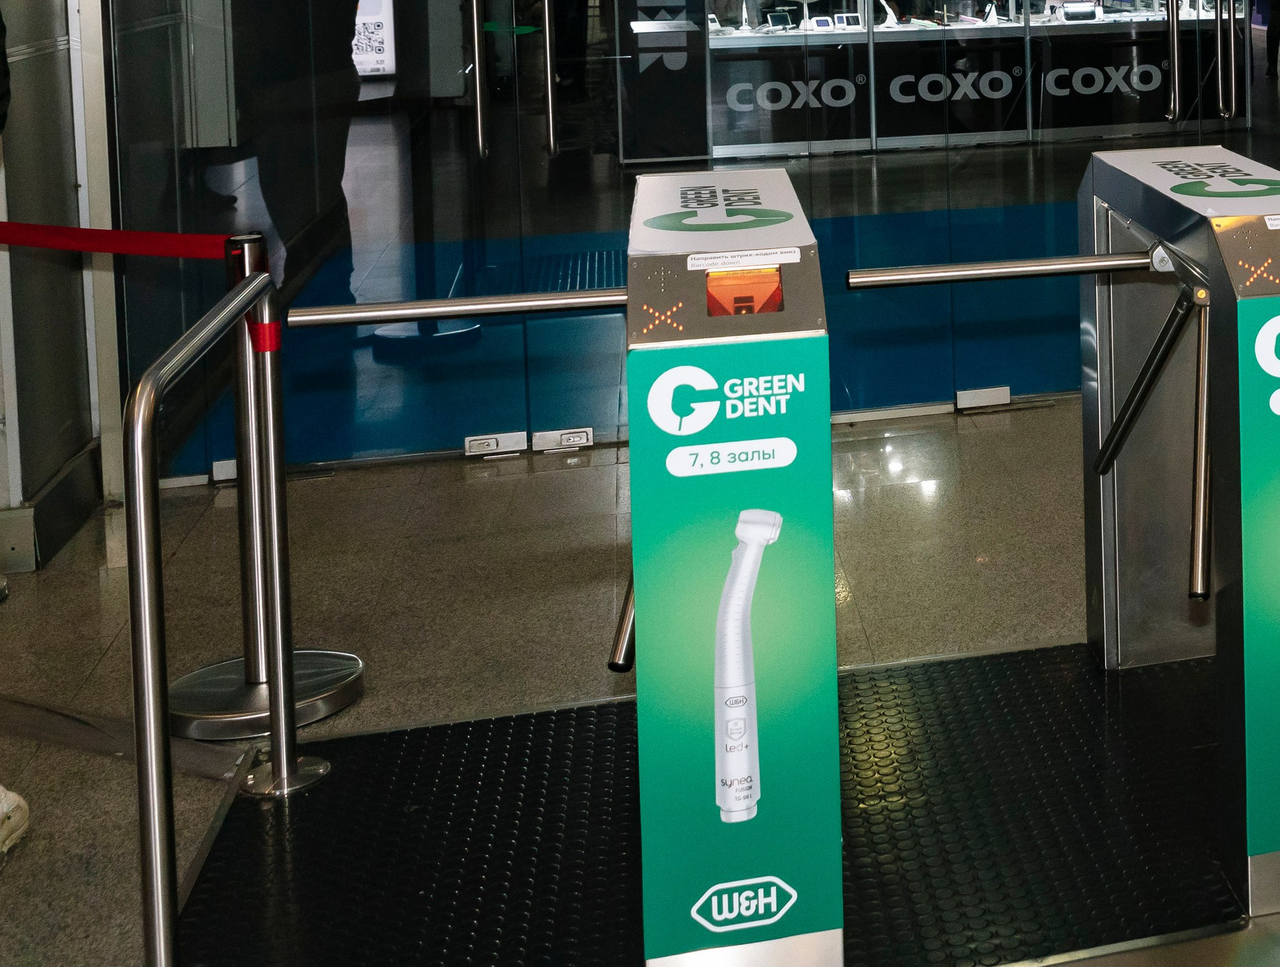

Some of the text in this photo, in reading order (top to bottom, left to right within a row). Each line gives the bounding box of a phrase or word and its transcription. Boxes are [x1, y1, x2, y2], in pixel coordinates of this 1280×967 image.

[1152, 160, 1215, 179] GREEN
[1194, 162, 1254, 178] DENT
[680, 185, 719, 209] GREEN
[722, 188, 762, 207] DENT
[690, 253, 729, 261] Направить
[730, 251, 778, 259] штрих-кодом
[723, 373, 805, 398] GREEN
[725, 394, 790, 419] DENT
[689, 448, 775, 469] 7, 8 залы
[725, 741, 750, 753] led+
[720, 775, 753, 789] synea
[735, 785, 753, 793] FUSION
[711, 885, 777, 922] W&H
